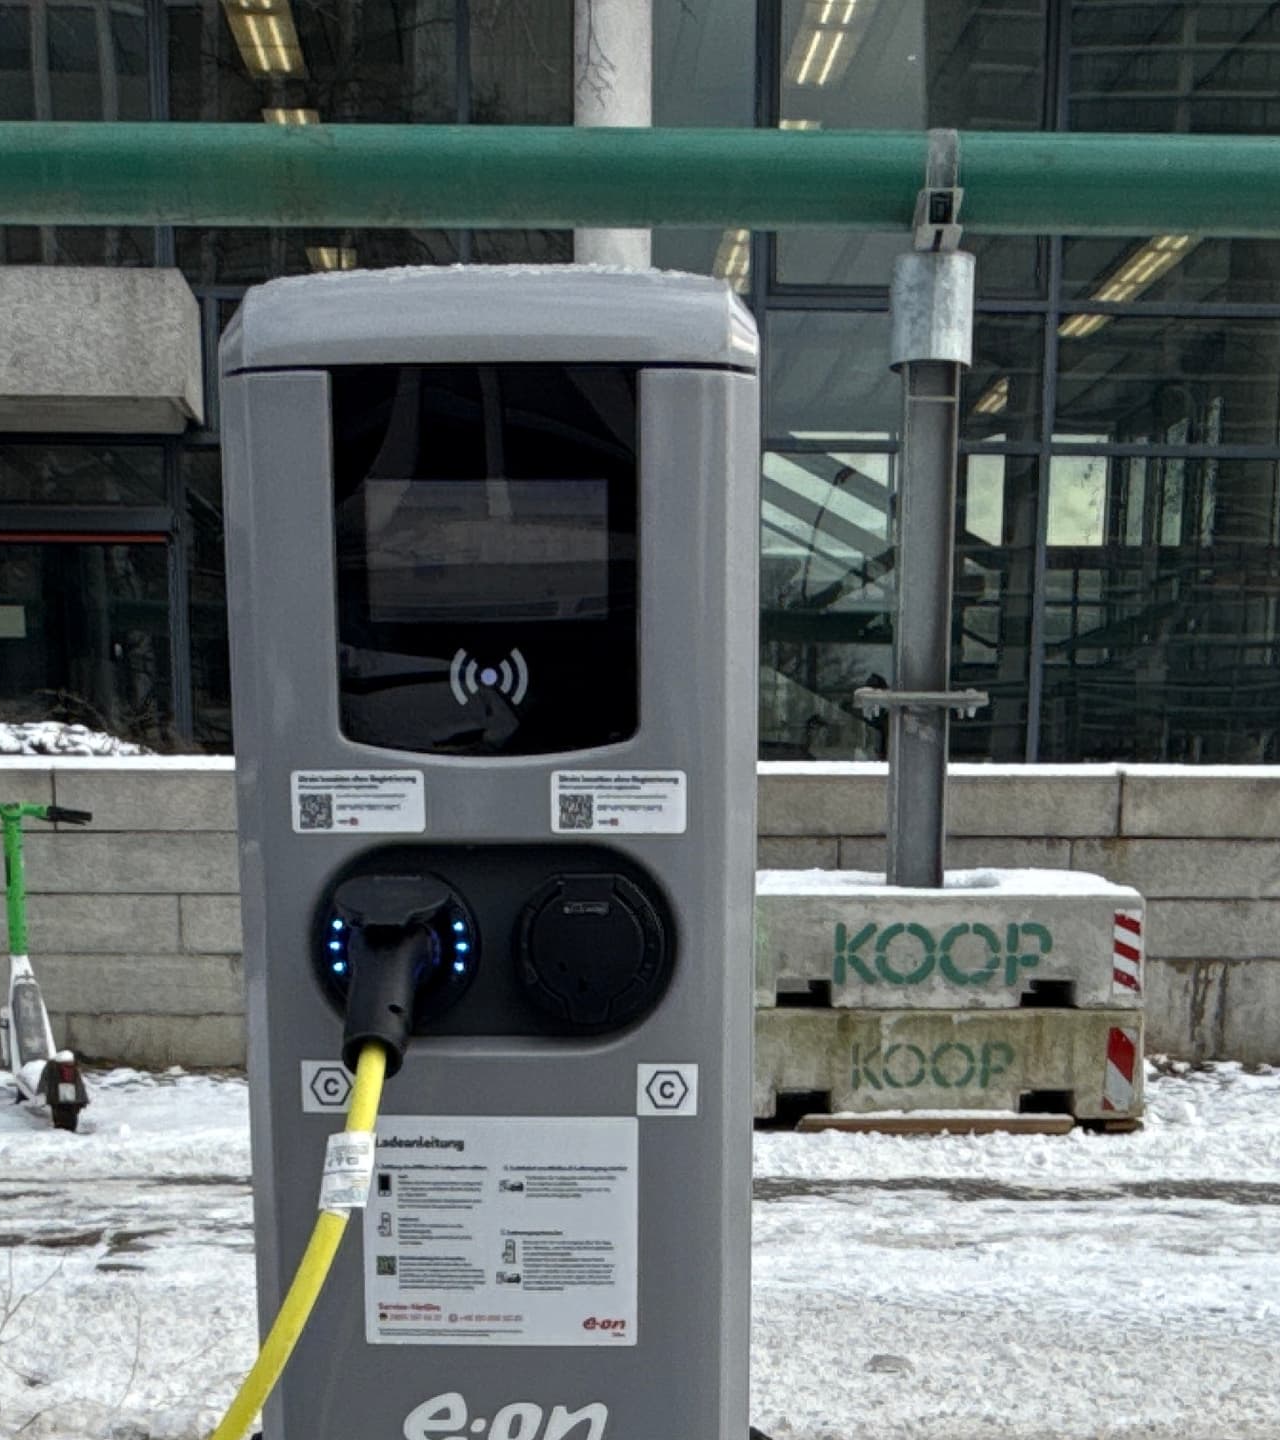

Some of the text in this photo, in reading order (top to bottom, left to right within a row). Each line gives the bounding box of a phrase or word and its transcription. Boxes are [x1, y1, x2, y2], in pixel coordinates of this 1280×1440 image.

[833, 922, 1053, 986] KOOP
[851, 1042, 1015, 1089] KOOP
[323, 1078, 340, 1096] C
[659, 1080, 676, 1098] C
[376, 1136, 465, 1151] Ladeanleitung
